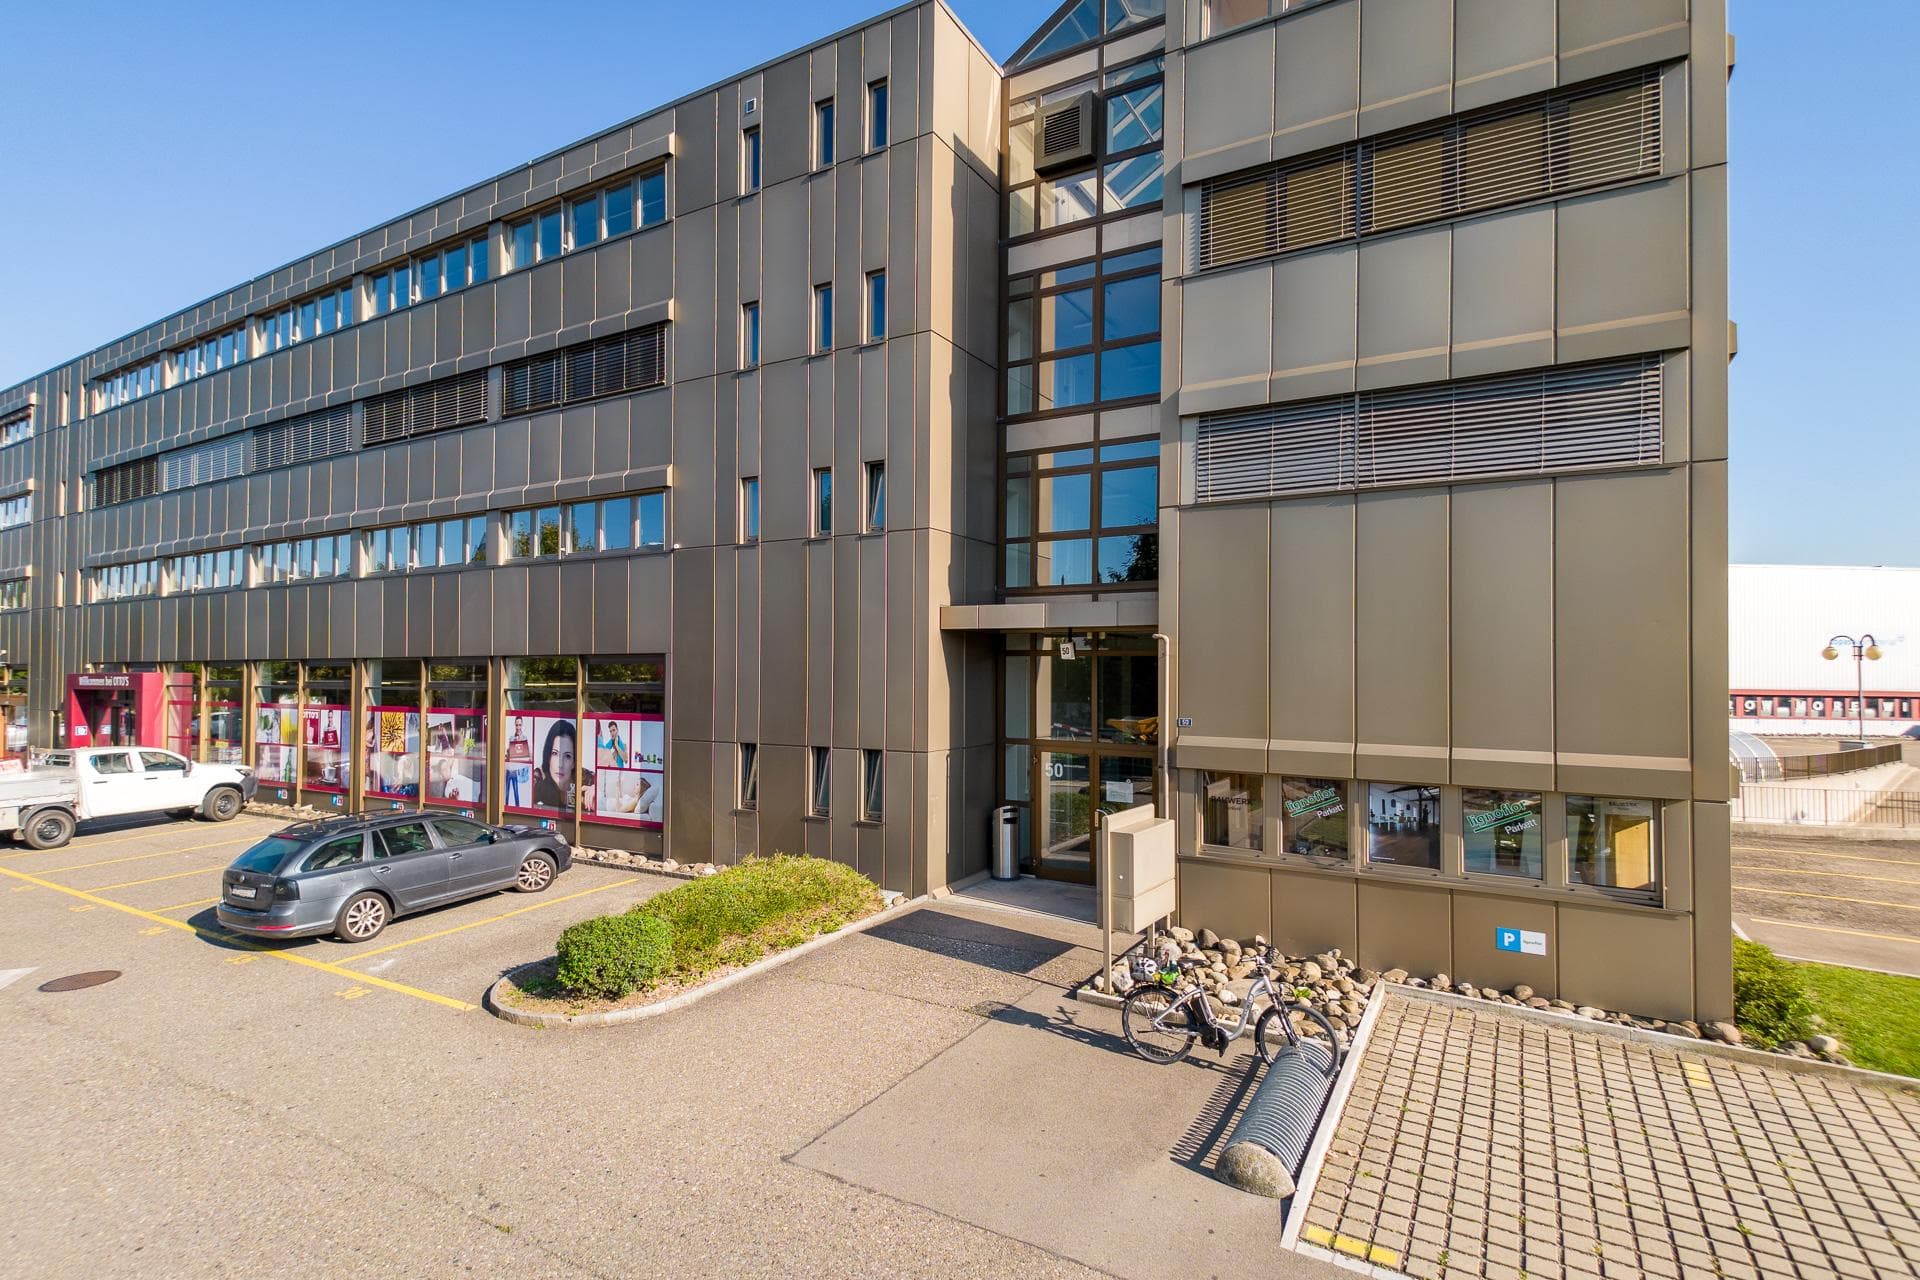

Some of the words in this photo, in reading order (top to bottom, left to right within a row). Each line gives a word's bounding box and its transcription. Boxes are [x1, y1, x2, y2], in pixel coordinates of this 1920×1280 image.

[1061, 646, 1070, 656] 50
[113, 676, 130, 687] OTTO'S
[1045, 762, 1063, 778] 50
[1285, 788, 1336, 812] lignoflor
[1316, 804, 1345, 818] Parkett
[1467, 802, 1527, 828] lignoflor
[1504, 819, 1538, 834] Parkett
[1503, 932, 1515, 947] P
